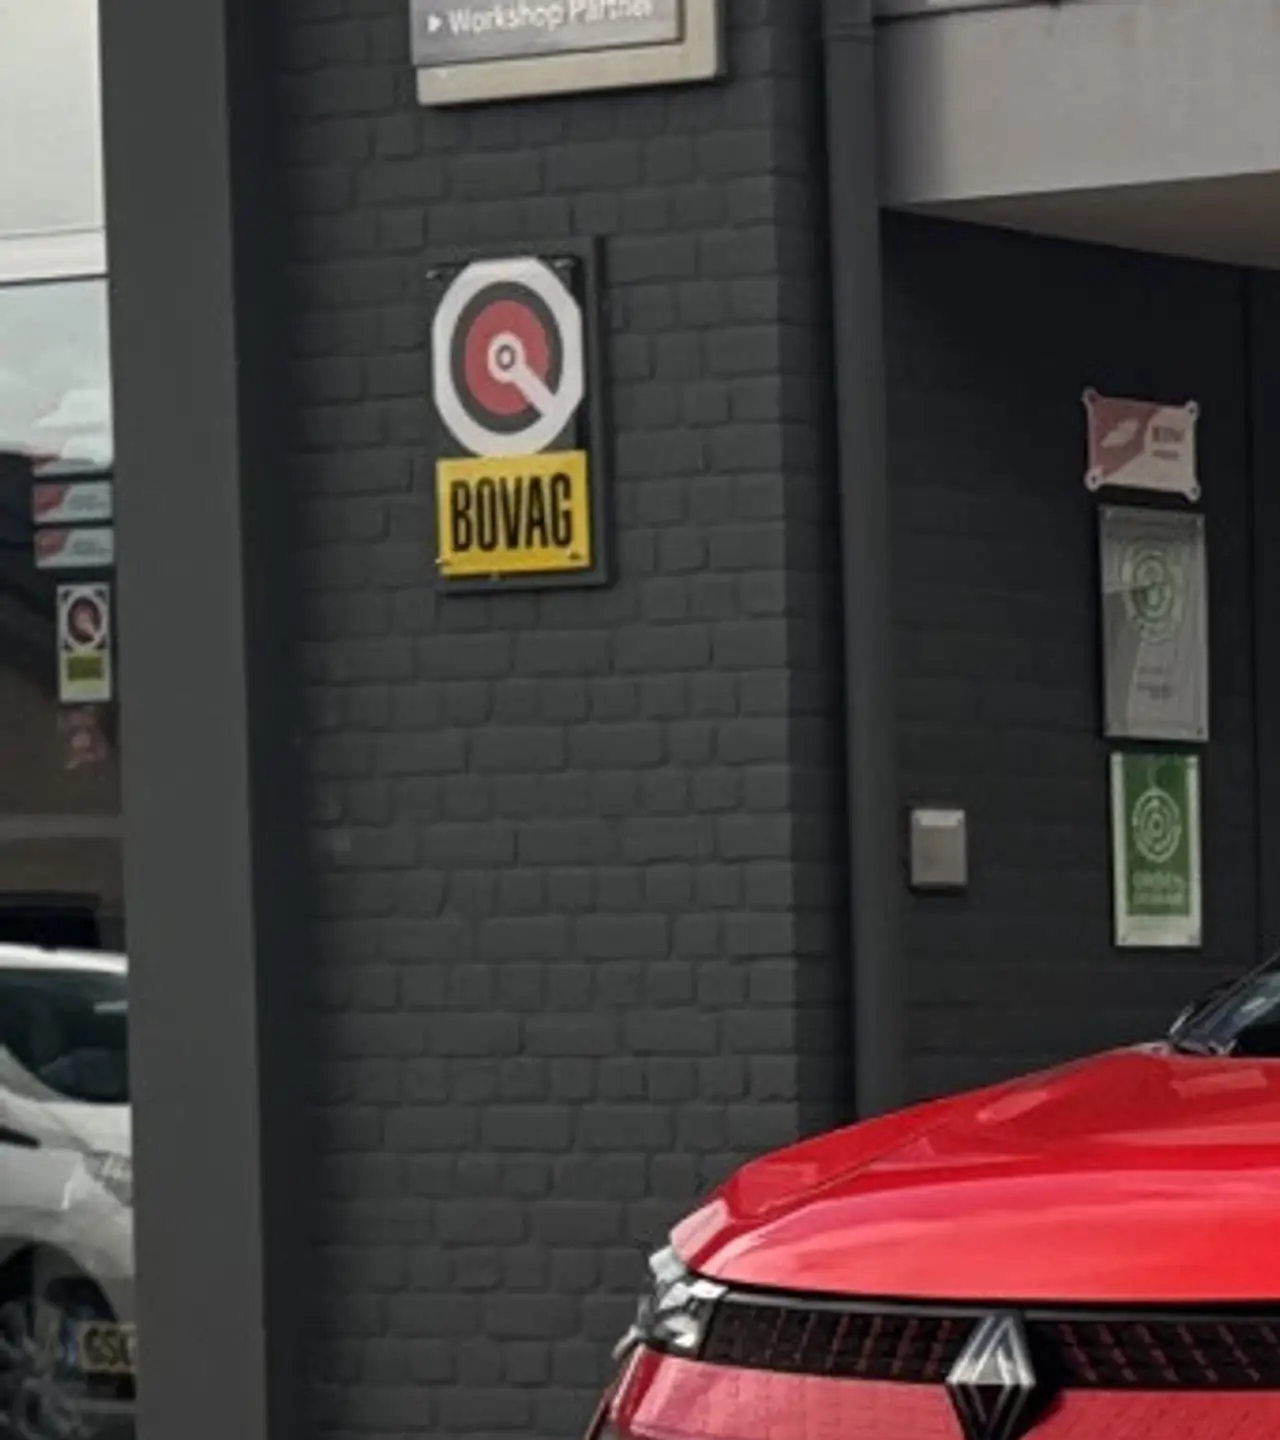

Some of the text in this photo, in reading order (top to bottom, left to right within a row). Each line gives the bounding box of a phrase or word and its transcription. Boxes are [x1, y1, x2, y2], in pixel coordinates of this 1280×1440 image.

[449, 0, 657, 34] Workshop Partner
[450, 472, 572, 553] BOVAG
